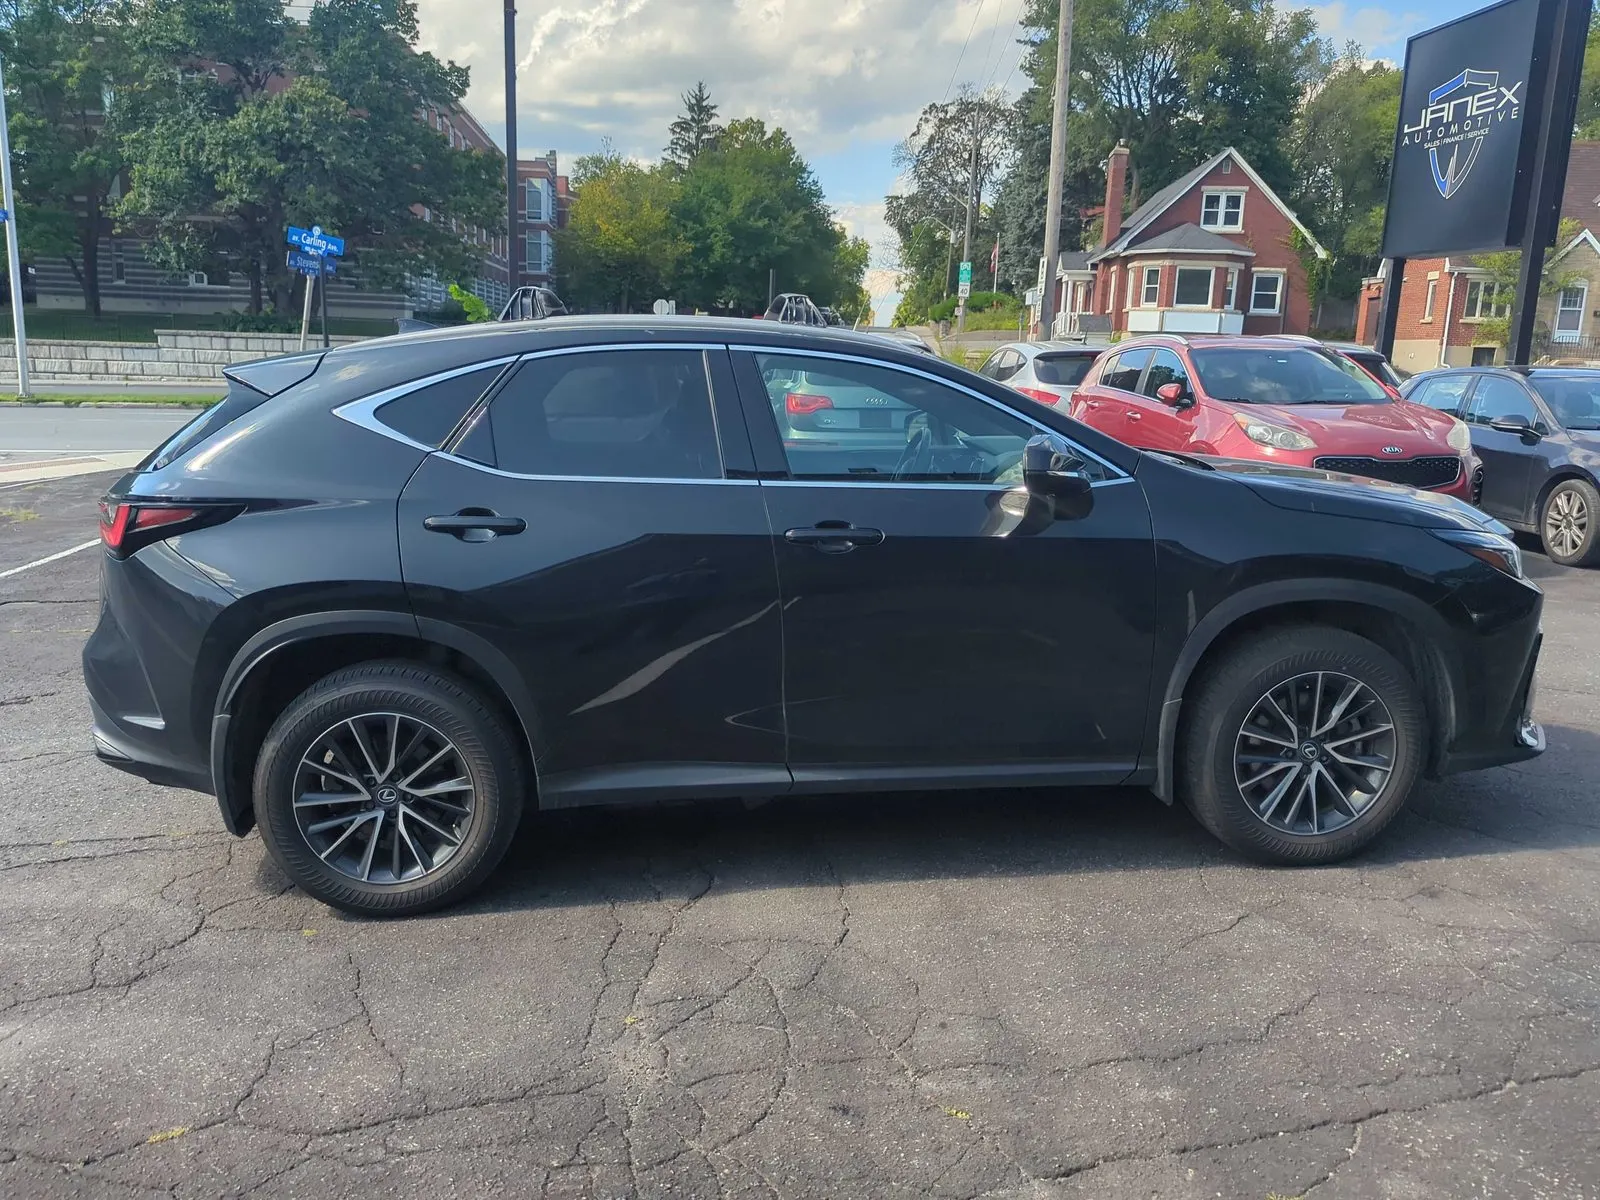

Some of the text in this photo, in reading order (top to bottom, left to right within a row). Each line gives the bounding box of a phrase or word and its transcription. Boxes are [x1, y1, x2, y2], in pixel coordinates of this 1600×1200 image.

[1403, 81, 1523, 133] JANEX
[1402, 106, 1519, 147] AUTOMOTIVE
[1423, 128, 1489, 149] SALES FINANCE SERVICE
[301, 233, 326, 251] Carling
[960, 287, 969, 296] 40
